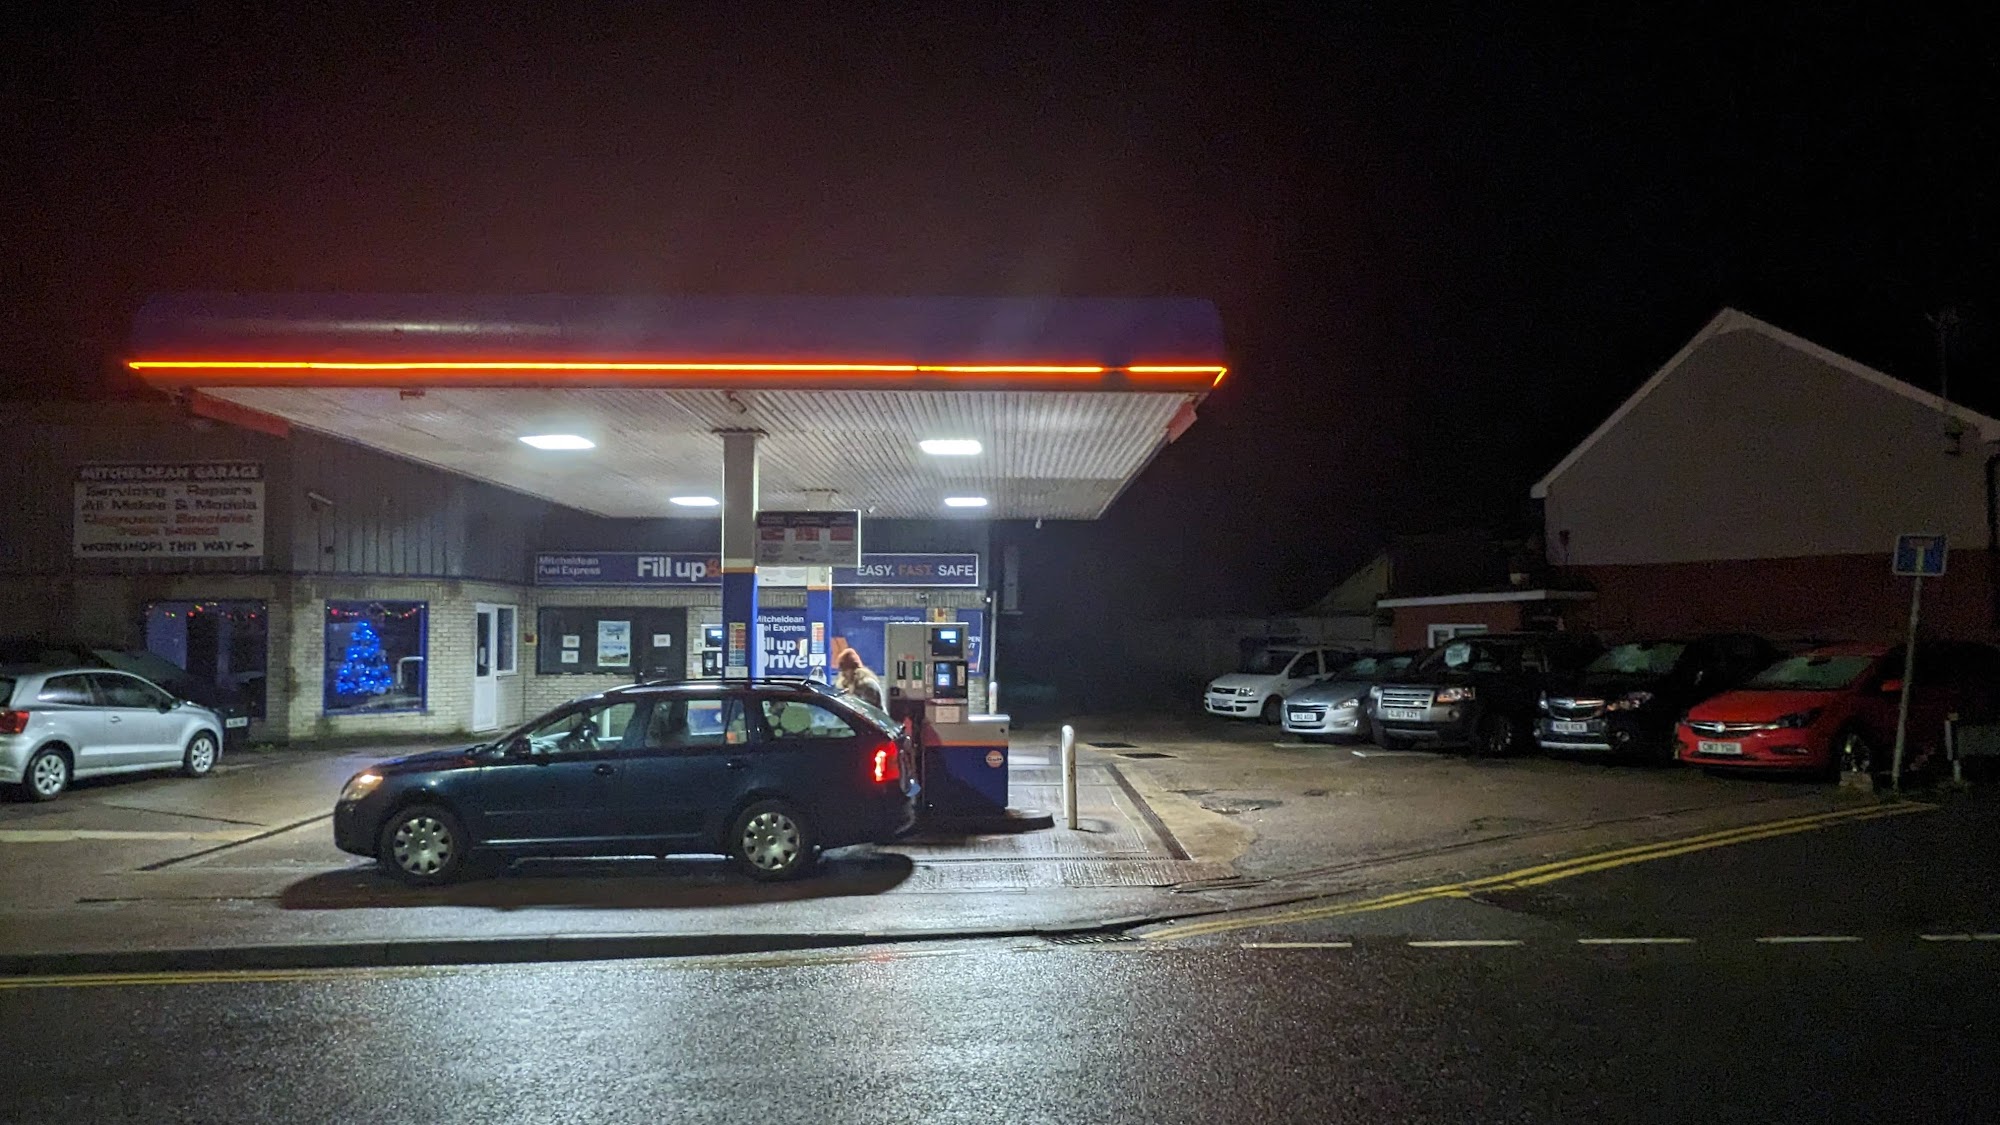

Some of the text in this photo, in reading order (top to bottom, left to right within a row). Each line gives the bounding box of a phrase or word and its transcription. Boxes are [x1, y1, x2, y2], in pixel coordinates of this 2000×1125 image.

[194, 466, 257, 478] GARAGE
[203, 541, 234, 551] WAY
[539, 556, 599, 565] Mitcheldean
[539, 566, 600, 577] Fuel Express
[637, 557, 672, 577] Fill
[676, 562, 706, 582] up
[773, 624, 806, 633] Express
[777, 640, 797, 653] up
